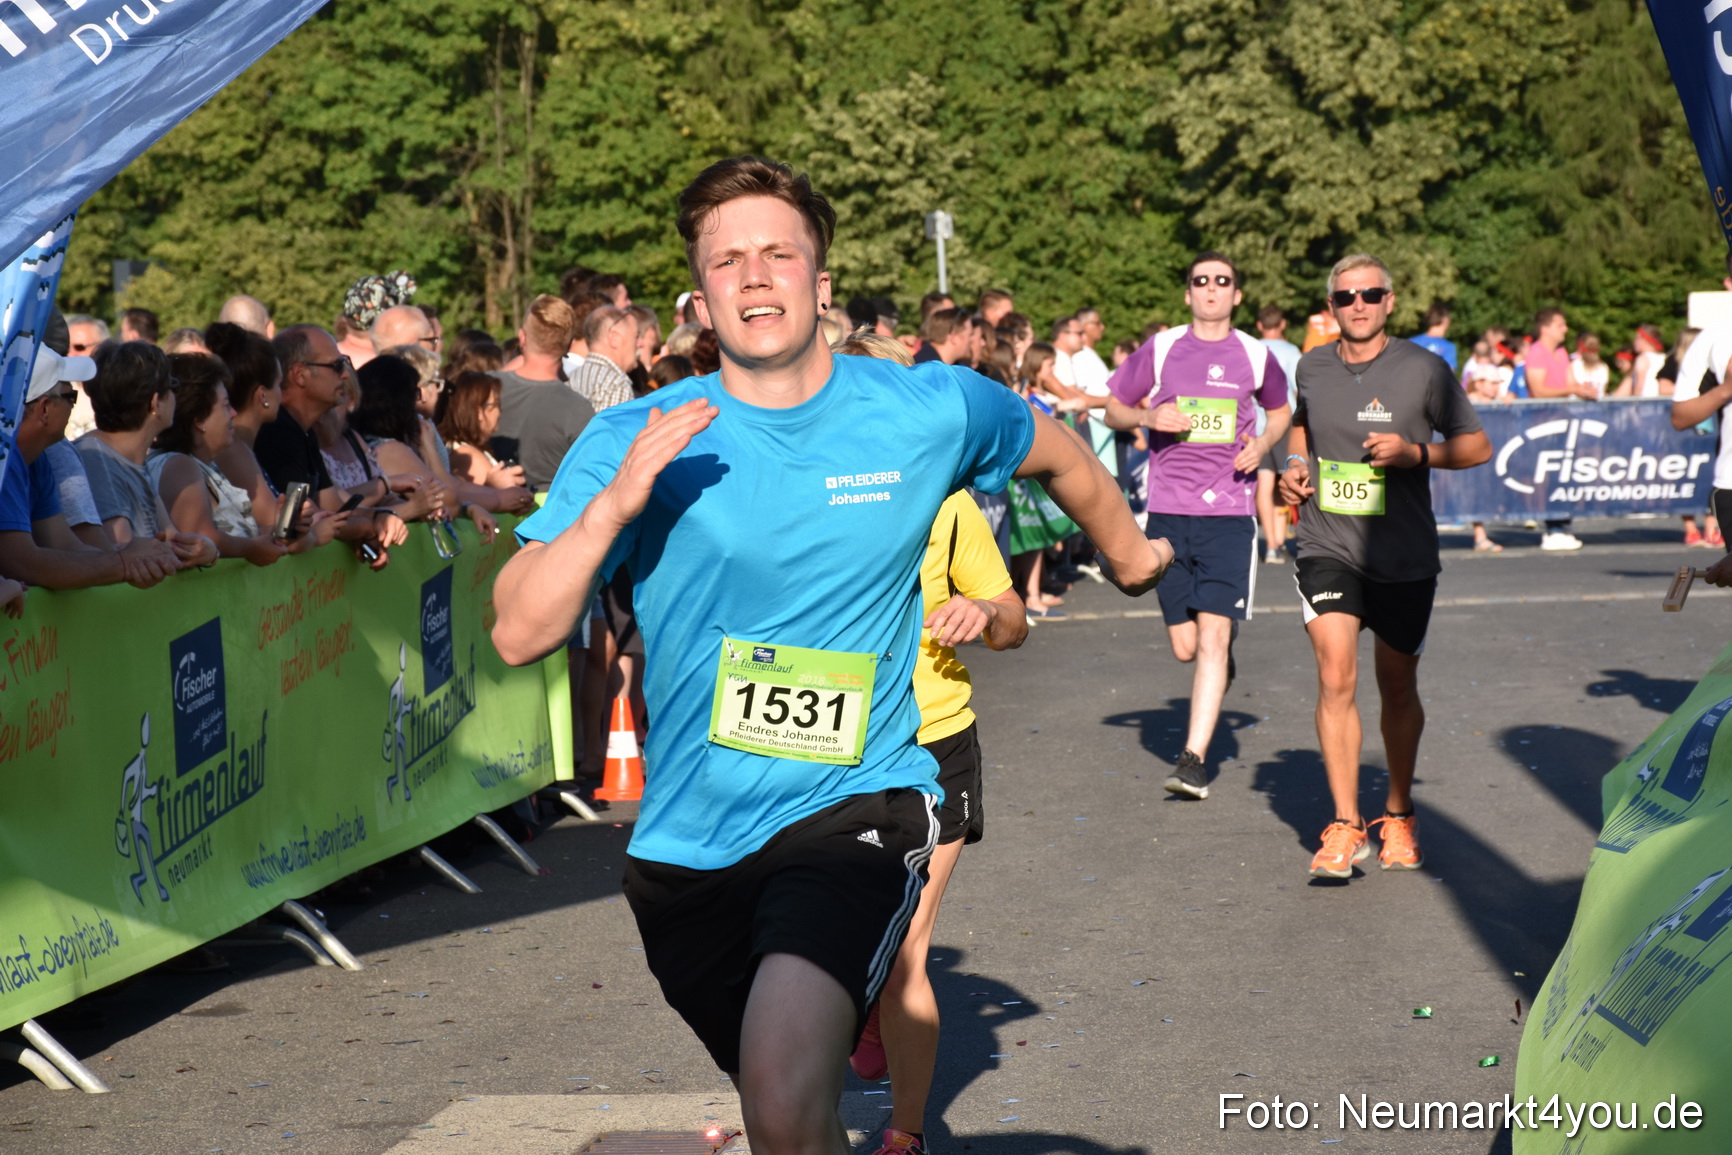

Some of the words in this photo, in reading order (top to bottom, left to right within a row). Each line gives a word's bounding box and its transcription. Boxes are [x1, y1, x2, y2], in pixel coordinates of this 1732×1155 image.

[69, 0, 178, 66] Dru
[1191, 414, 1222, 430] 685
[1534, 447, 1710, 484] Fischer
[838, 471, 902, 488] PFLEIDERER
[1331, 481, 1368, 500] 305
[828, 491, 891, 506] Johannes
[1550, 483, 1696, 502] AUTOMOBILE
[740, 658, 795, 674] firmenlauf
[182, 667, 217, 702] Fischer
[736, 682, 846, 732] 1531
[729, 730, 767, 745] Pfleiderer
[768, 738, 818, 753] Deutschland
[819, 745, 844, 754] GmbH
[737, 721, 779, 738] Endres
[782, 729, 839, 745] Johannes
[156, 709, 268, 856] firmenlauf
[167, 831, 213, 889] neumarkt
